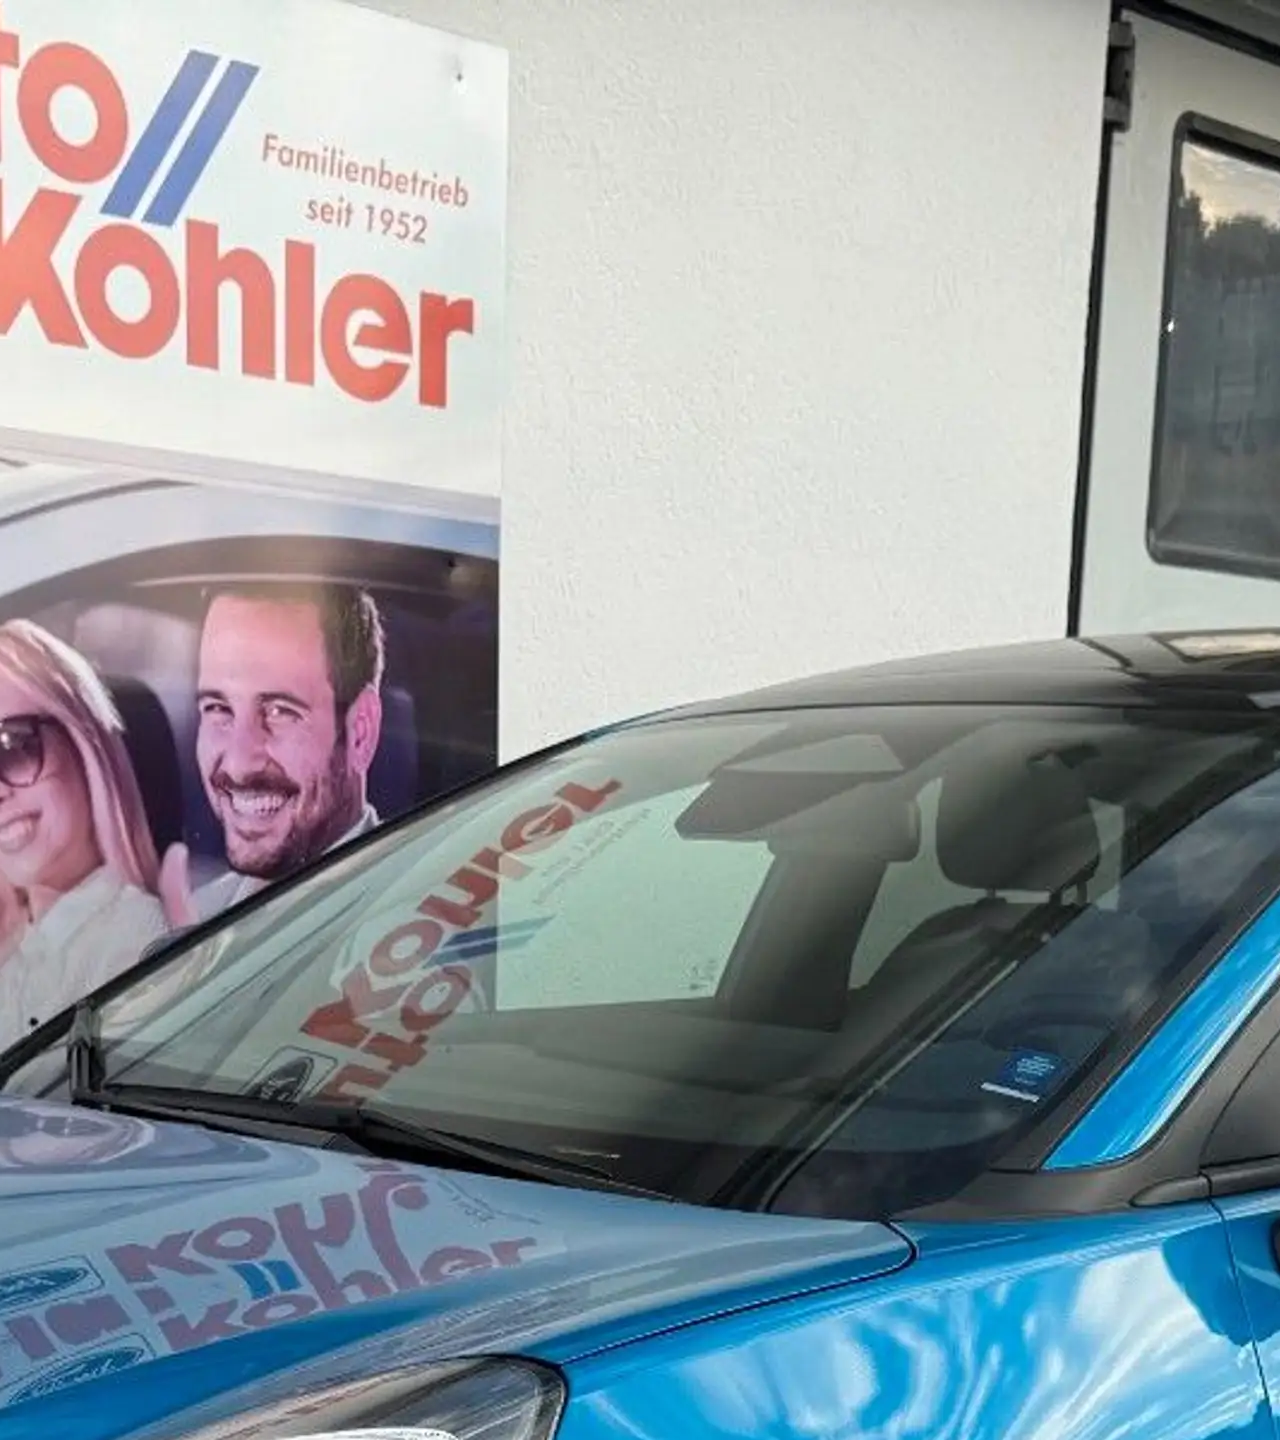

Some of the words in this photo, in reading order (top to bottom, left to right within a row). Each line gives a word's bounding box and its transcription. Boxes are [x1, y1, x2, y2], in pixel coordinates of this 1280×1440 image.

[261, 132, 470, 208] Familienbetrieb
[306, 195, 354, 229] seit
[365, 203, 429, 245] 1952
